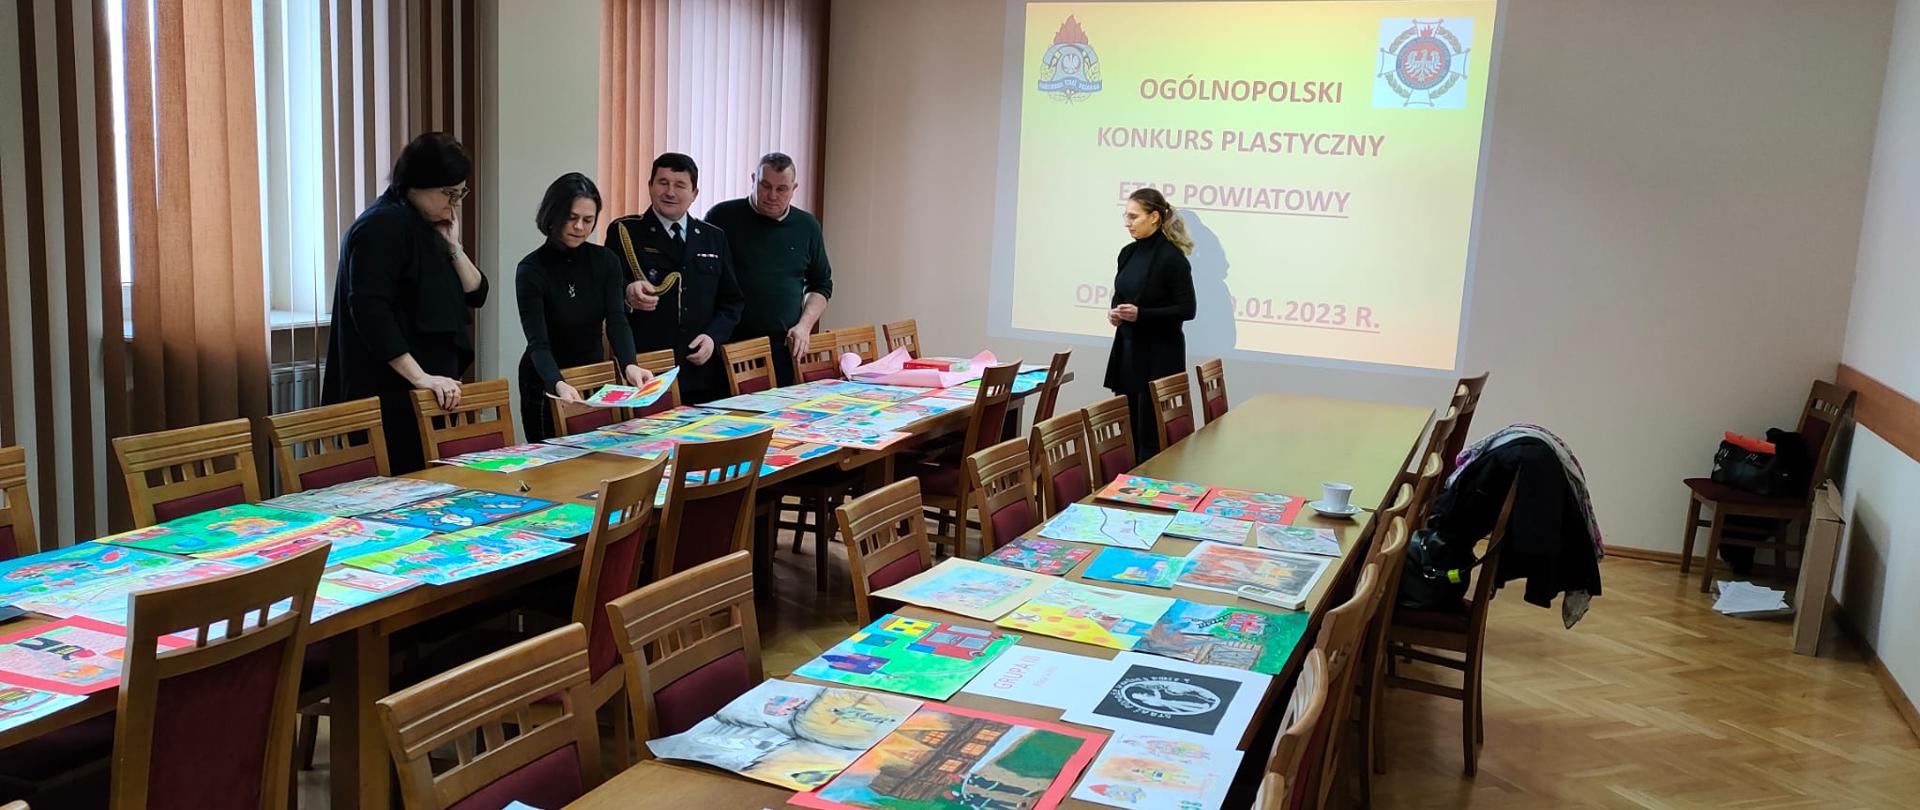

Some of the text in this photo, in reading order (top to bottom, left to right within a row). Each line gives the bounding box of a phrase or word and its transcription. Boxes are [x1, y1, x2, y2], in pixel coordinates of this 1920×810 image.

[1139, 74, 1343, 103] OGÓLNOPOLSKI
[1097, 127, 1385, 157] KONKURS PLASTYCZNY
[1118, 181, 1351, 213] EP POWIATOWY
[1231, 296, 1346, 326] .01.2023
[1355, 306, 1380, 329] R.
[993, 660, 1033, 689] GRUPA
